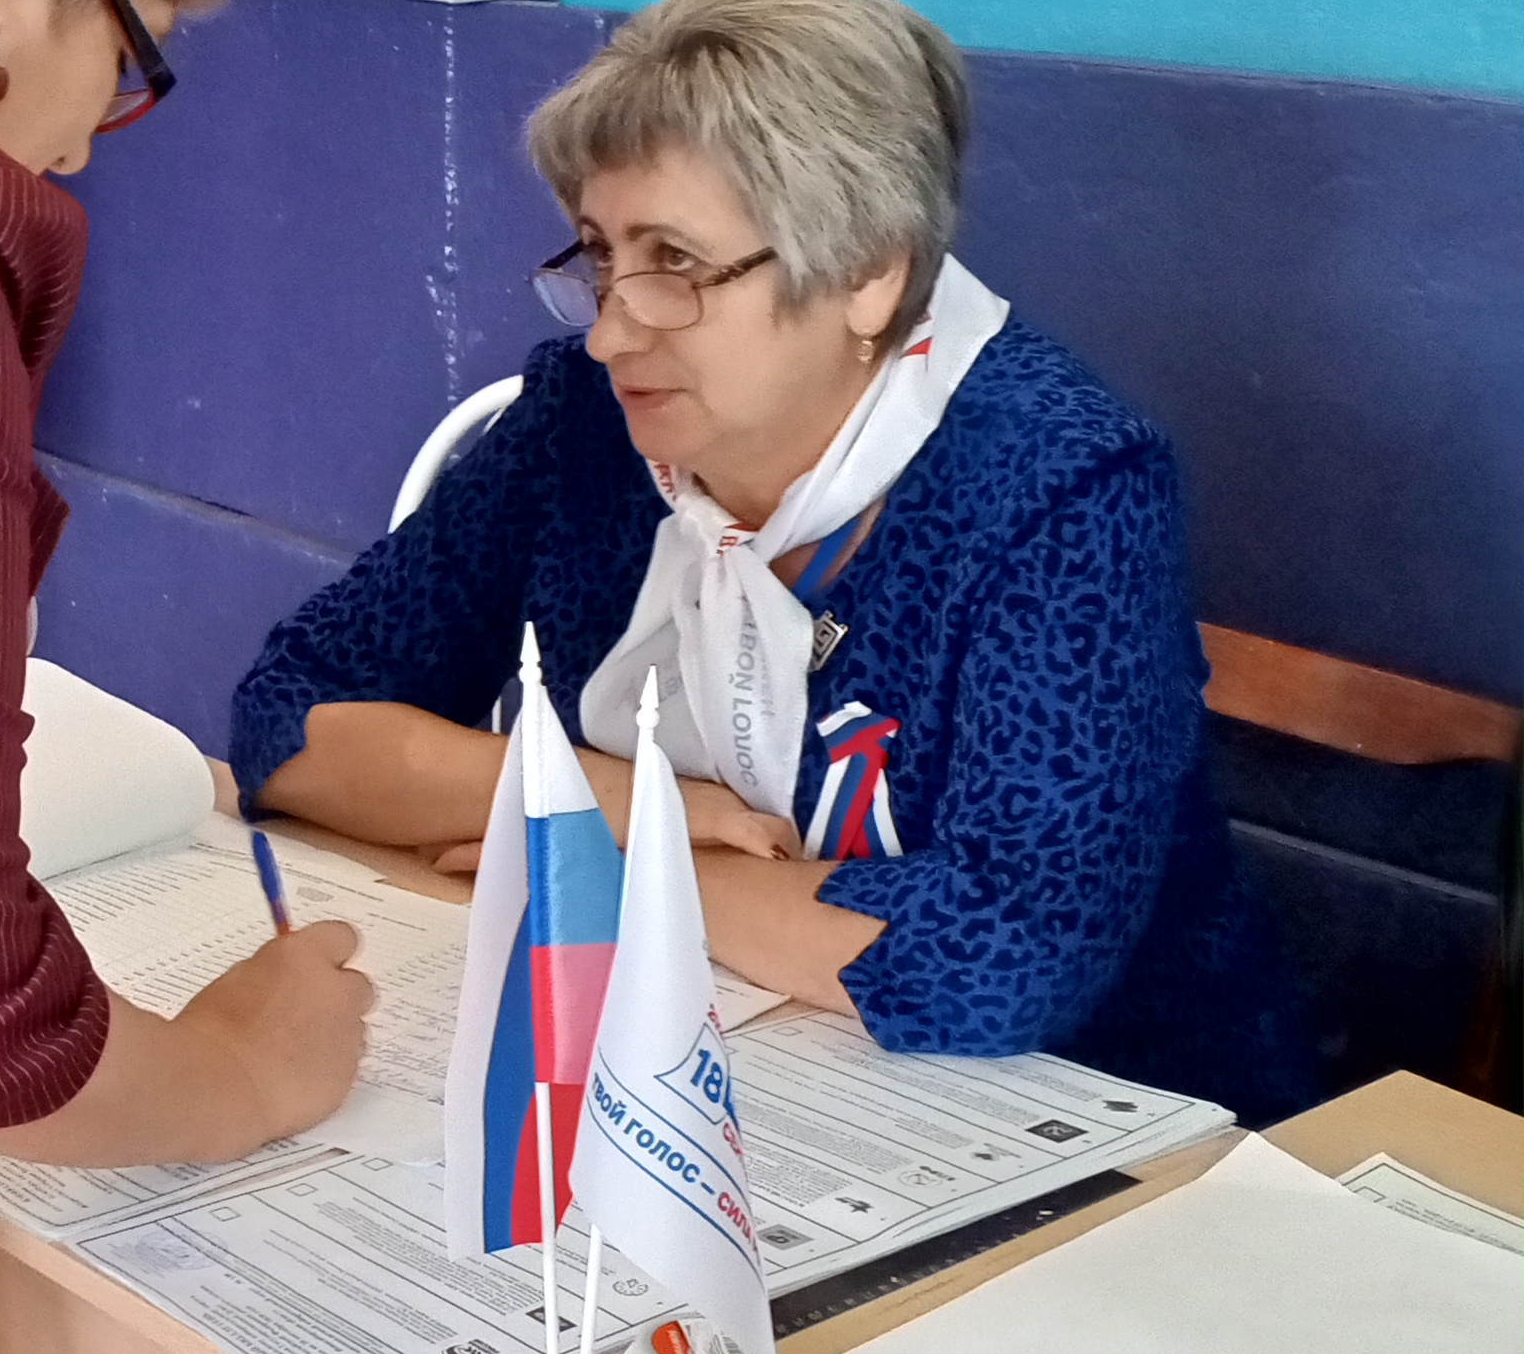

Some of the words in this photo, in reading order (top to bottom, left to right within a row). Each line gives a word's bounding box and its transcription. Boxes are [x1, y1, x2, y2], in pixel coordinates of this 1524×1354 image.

[593, 1072, 628, 1126] ТВОЙ
[625, 1118, 701, 1184] ГОЛОС
[717, 1192, 759, 1254] СИЛ
